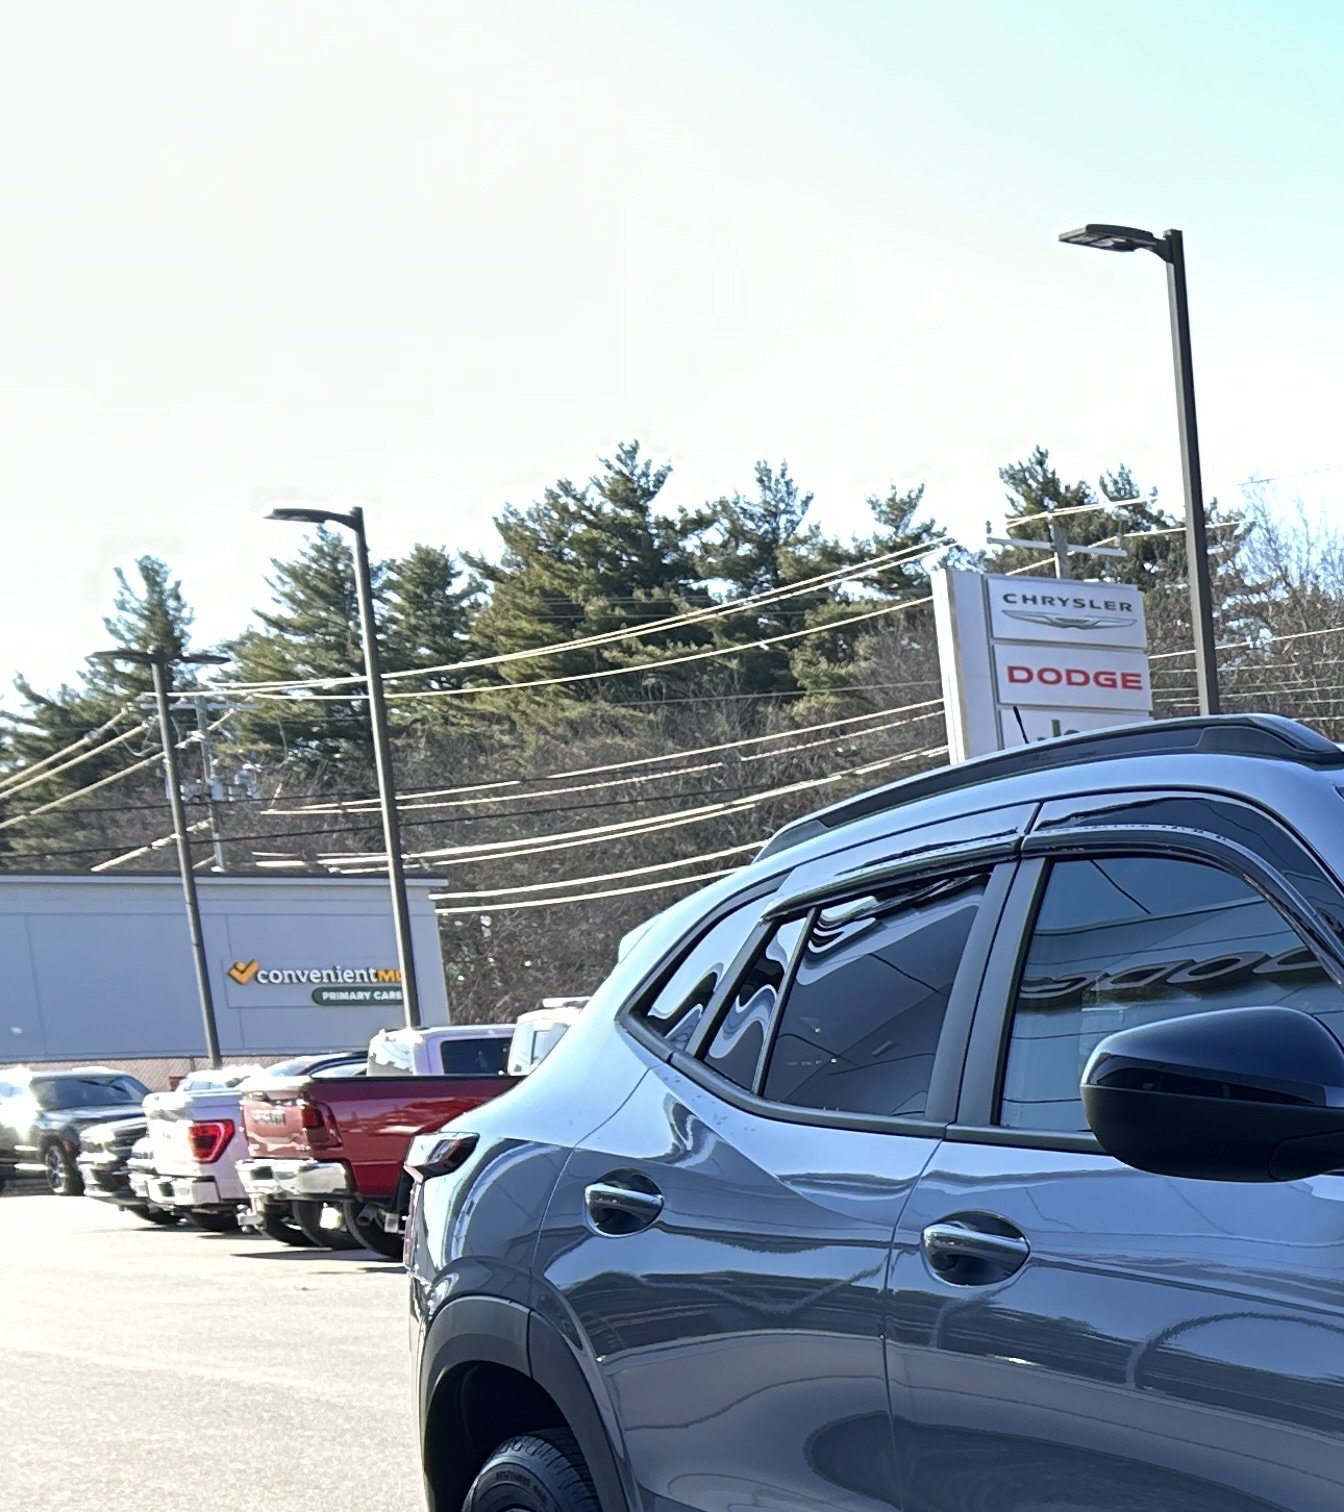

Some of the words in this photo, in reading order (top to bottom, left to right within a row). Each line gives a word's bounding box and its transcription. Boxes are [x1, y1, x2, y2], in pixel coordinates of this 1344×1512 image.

[1002, 592, 1133, 612] CHRYSLER
[1007, 665, 1143, 690] DODGE
[321, 990, 371, 1001] PRIMARY
[373, 990, 403, 1001] CARE
